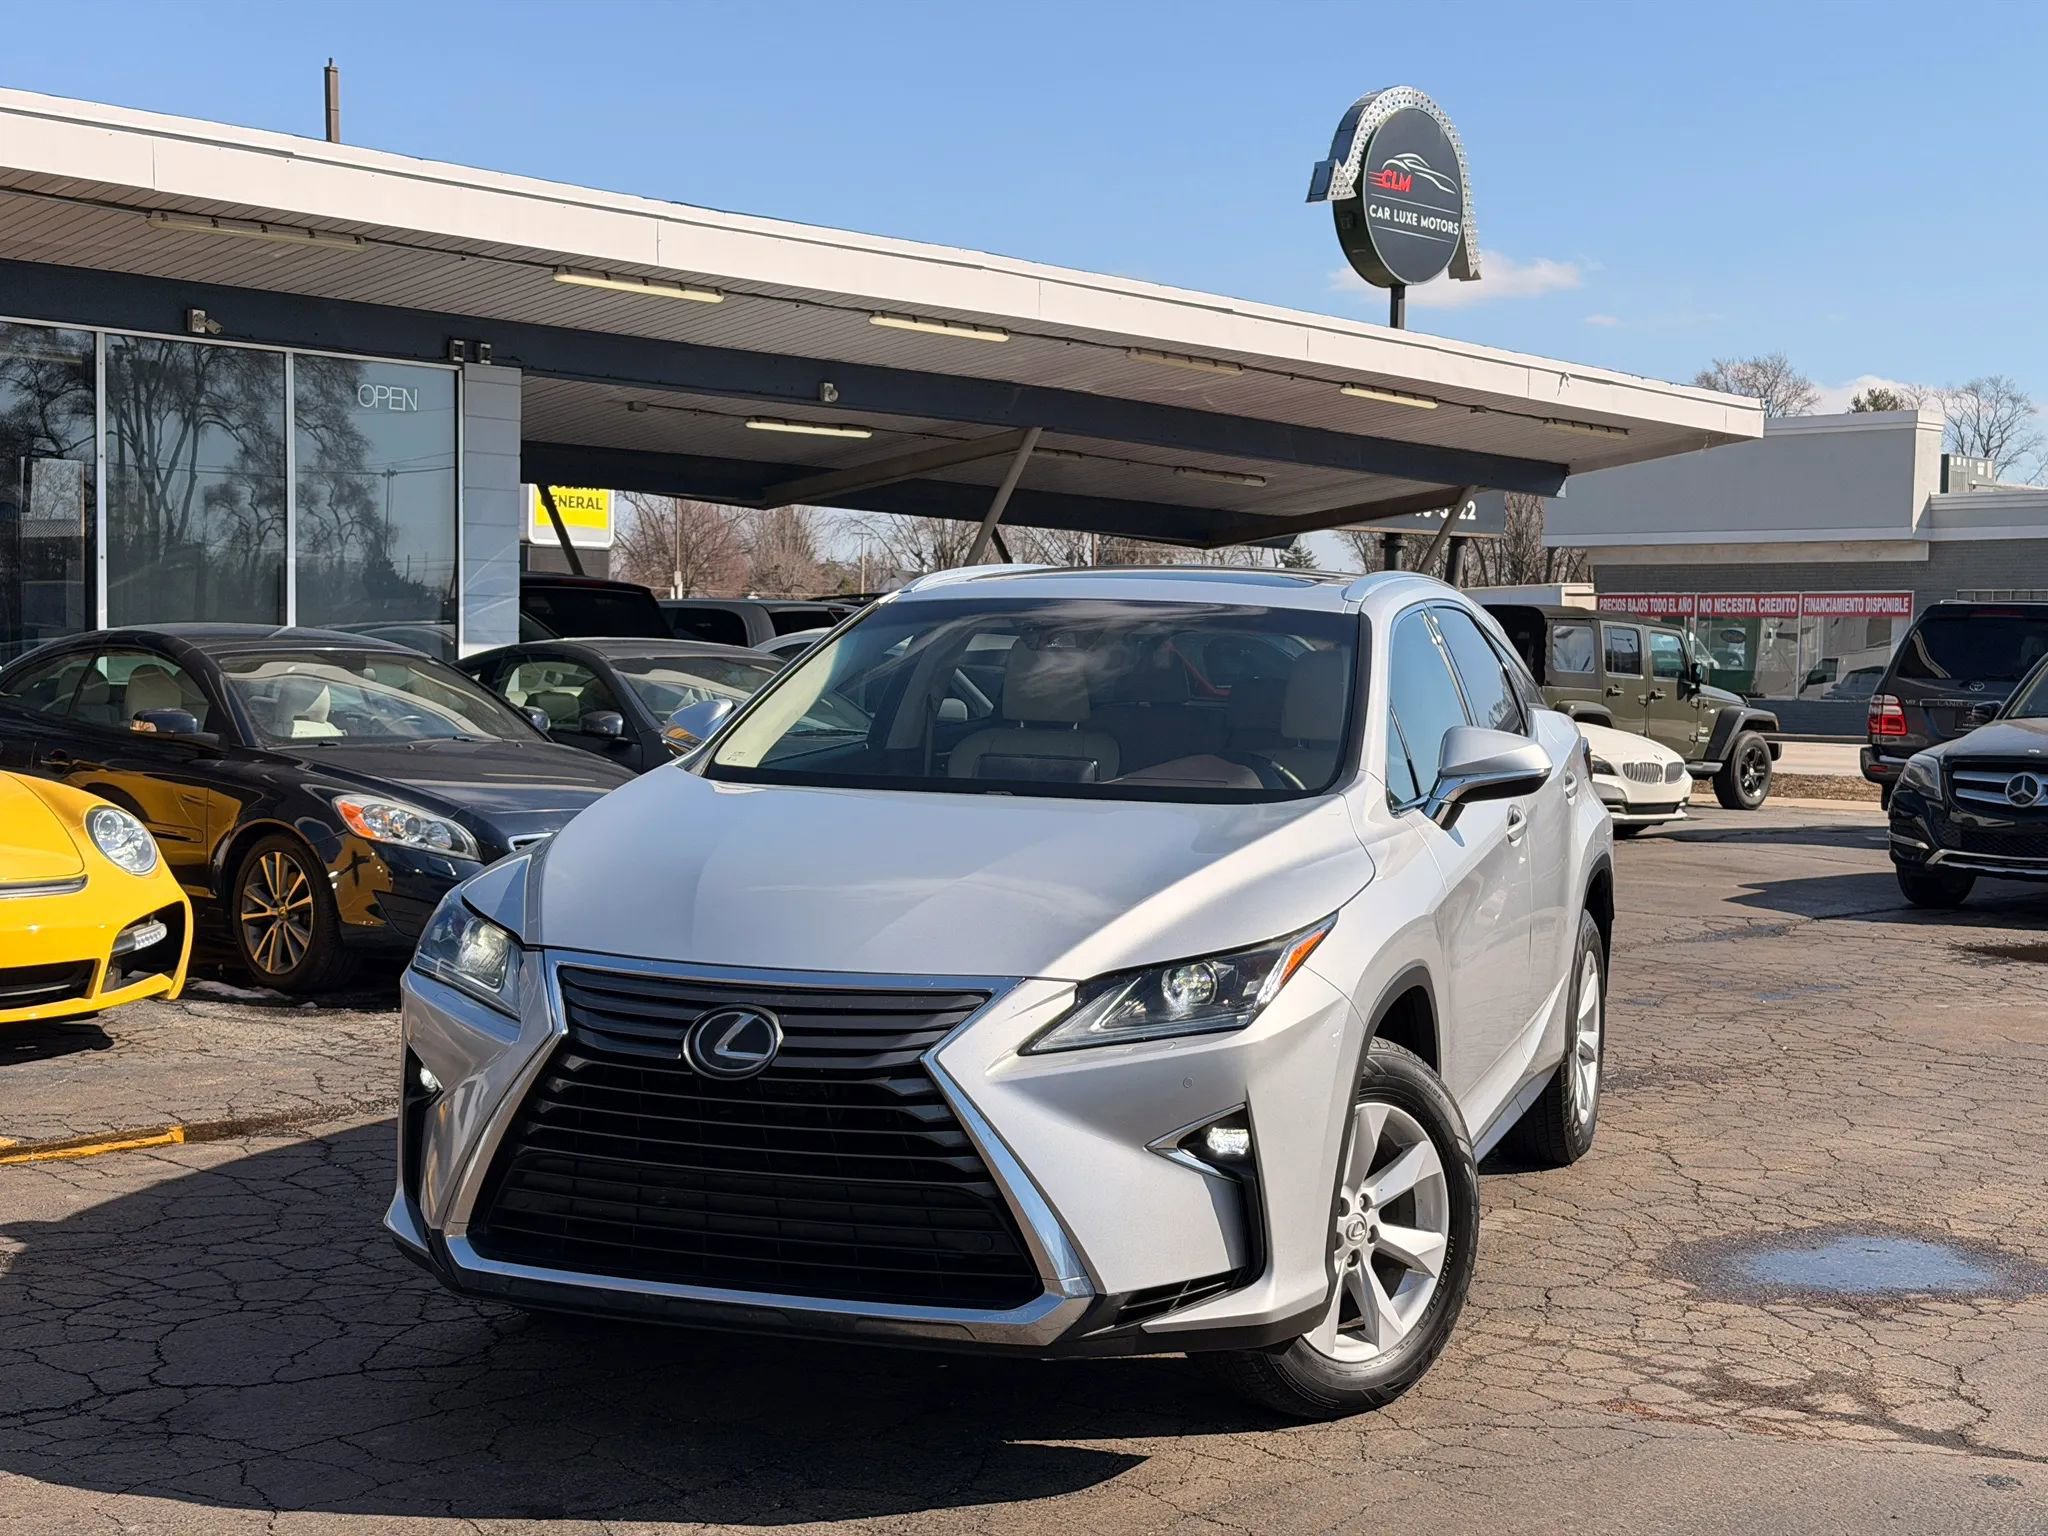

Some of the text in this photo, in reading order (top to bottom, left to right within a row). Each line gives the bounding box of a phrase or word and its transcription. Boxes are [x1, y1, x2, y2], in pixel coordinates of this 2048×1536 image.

[1381, 169, 1413, 193] CLM
[1369, 204, 1459, 235] CAR LUXE MOTORS
[358, 383, 418, 412] OPEN
[549, 494, 604, 511] NERAL
[1599, 596, 1693, 613] PRECIOS BAJOS TODO EL AÑO
[1700, 597, 1797, 613] NO NECESITA CREDITO
[1804, 597, 1909, 613] FINANCIAMIENTO DISPONIBLE
